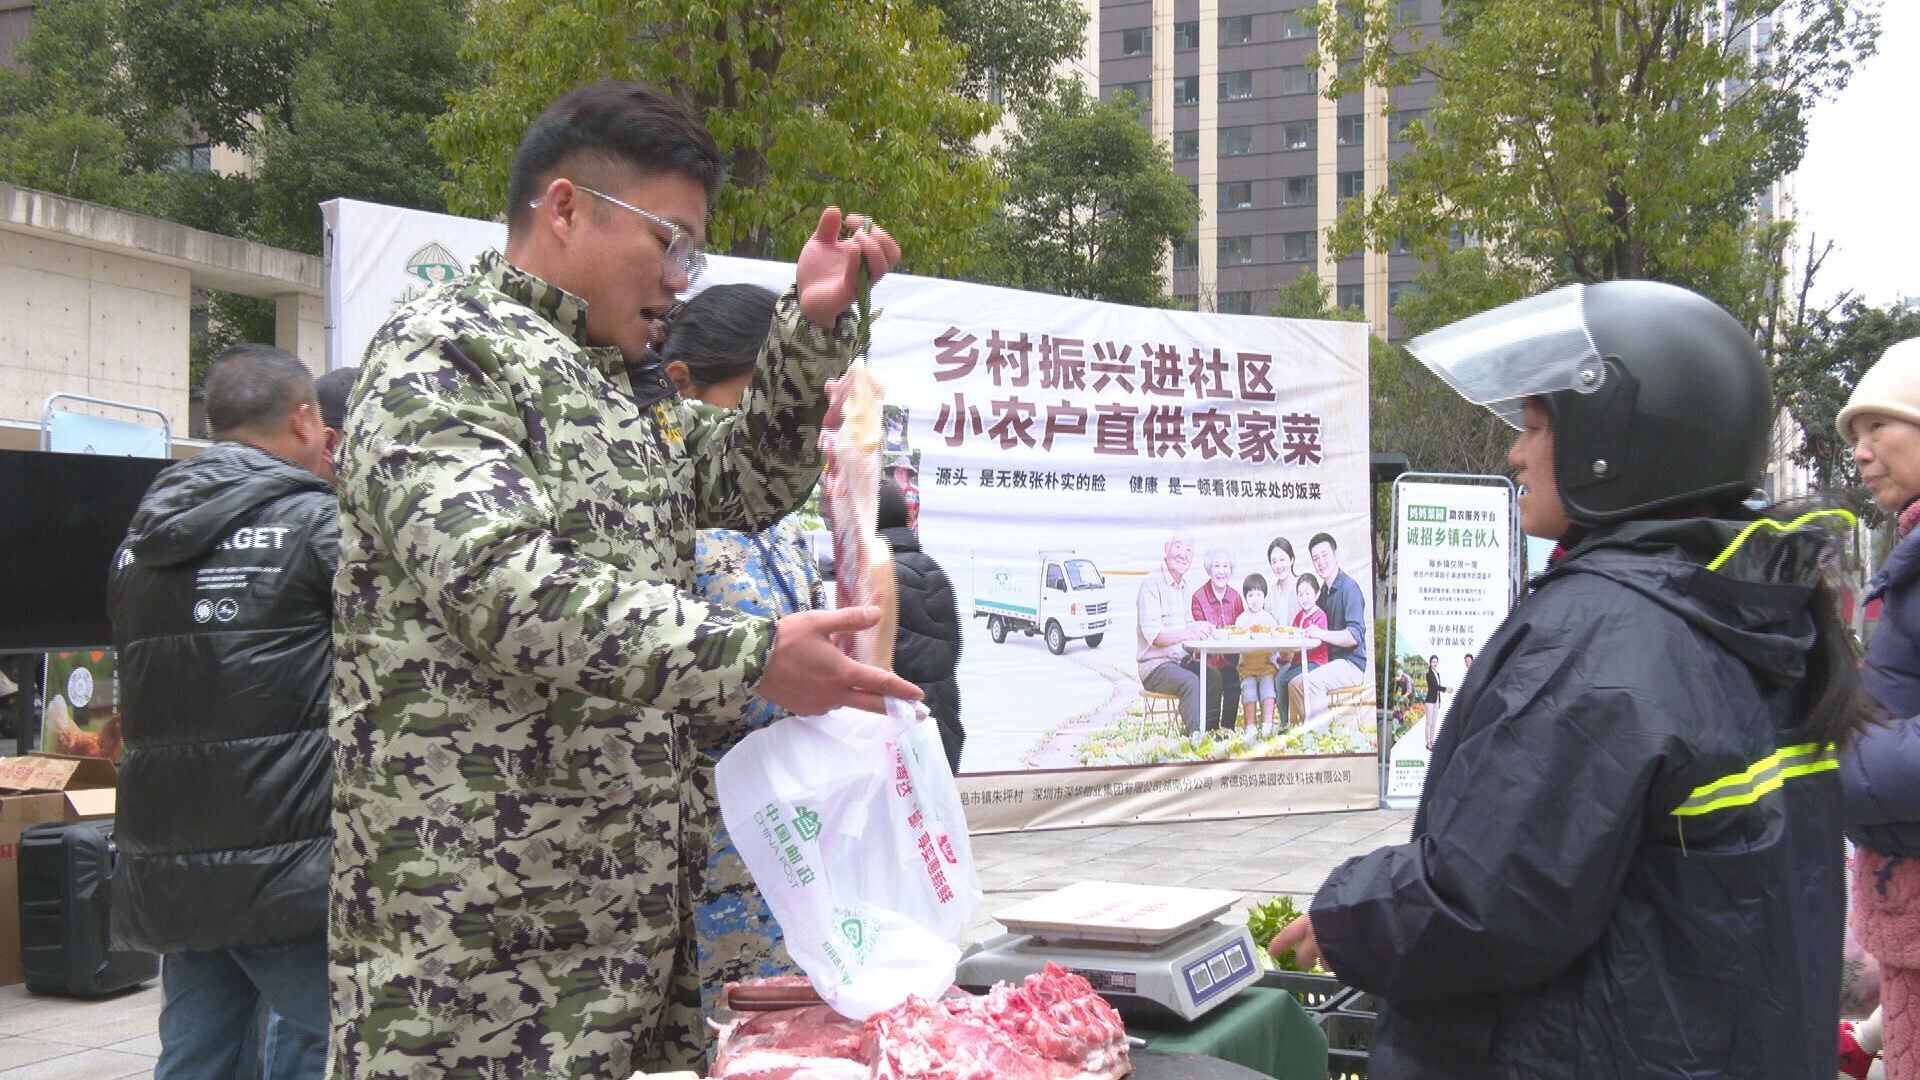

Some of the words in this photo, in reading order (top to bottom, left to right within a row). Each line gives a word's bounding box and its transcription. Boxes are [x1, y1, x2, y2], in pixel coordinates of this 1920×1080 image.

[933, 326, 1277, 402] 乡村振兴进社区
[933, 393, 1322, 466] 小农户直供农家菜
[935, 467, 968, 486] 源头
[979, 469, 1106, 493] 是无数张朴实的脸
[1129, 476, 1159, 494] 健康
[1169, 477, 1322, 500] 是一顿看得见来处的饭菜
[1449, 510, 1496, 522] 助农服务平台
[1407, 527, 1500, 548] 诚招乡镇合伙人
[1429, 624, 1475, 634] 助力乡村振兴
[1429, 636, 1475, 647] 守护食品安全
[1220, 769, 1352, 789] 常德妈妈菜园农业科技有限公司
[765, 802, 817, 887] 中国邮政
[779, 856, 801, 889] POST
